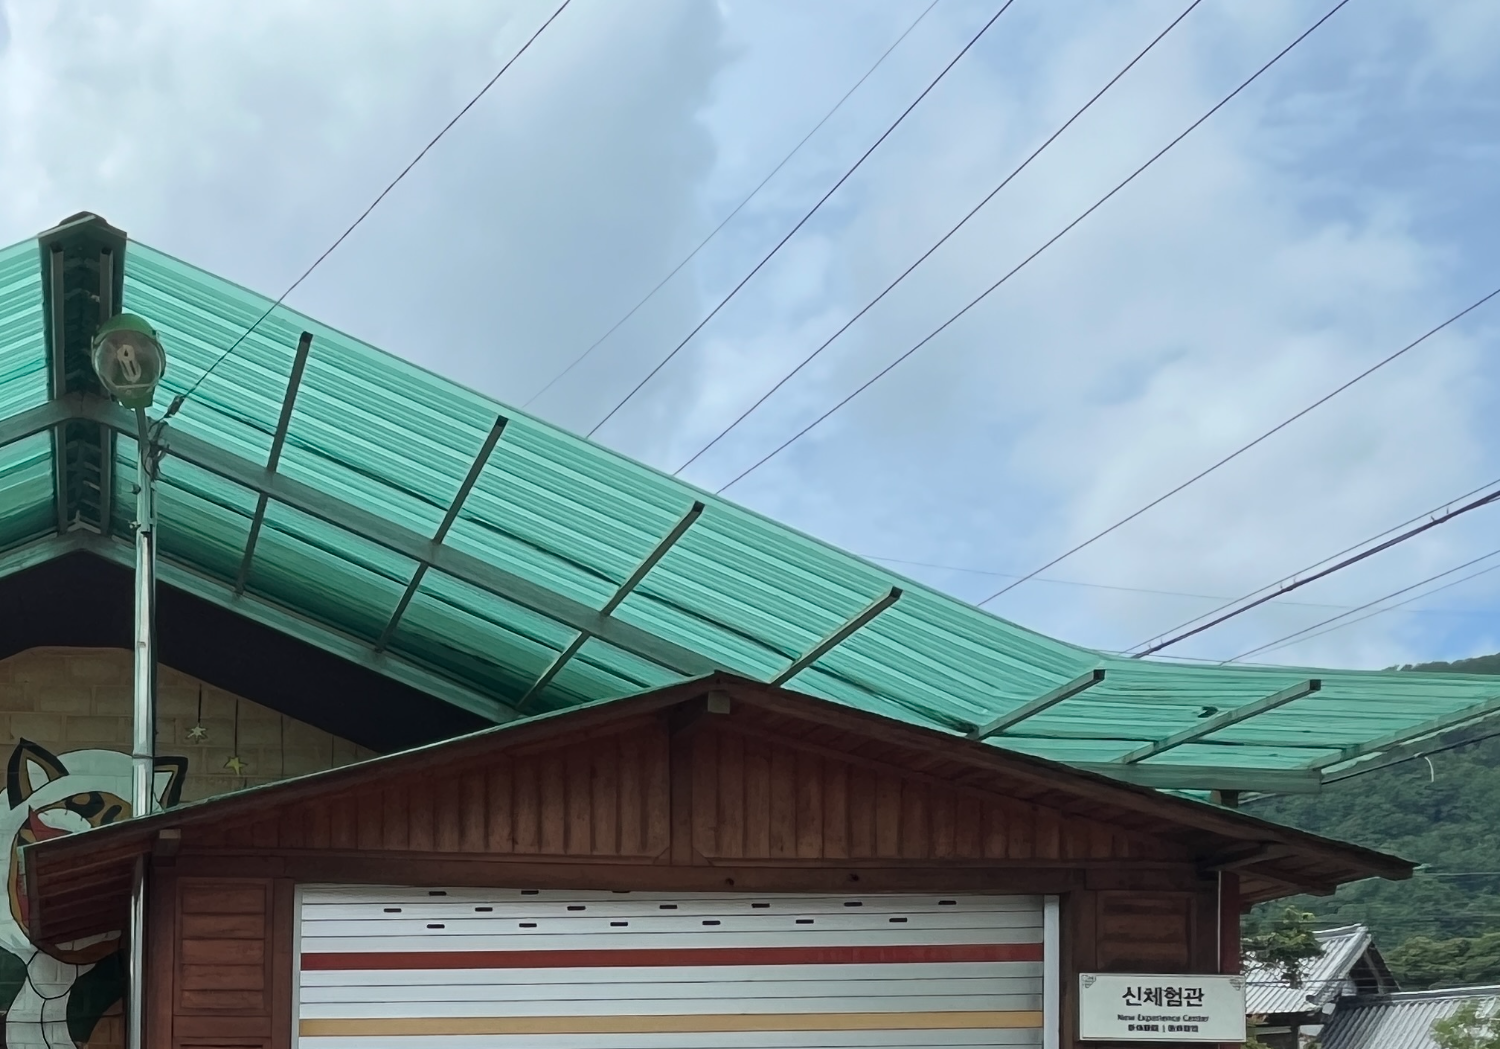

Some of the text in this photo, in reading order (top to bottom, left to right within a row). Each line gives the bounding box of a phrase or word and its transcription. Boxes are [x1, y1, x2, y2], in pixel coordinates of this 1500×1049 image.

[1122, 986, 1205, 1007] 신체험관
[1137, 1014, 1181, 1022] Experience
[1182, 1014, 1209, 1022] Center
